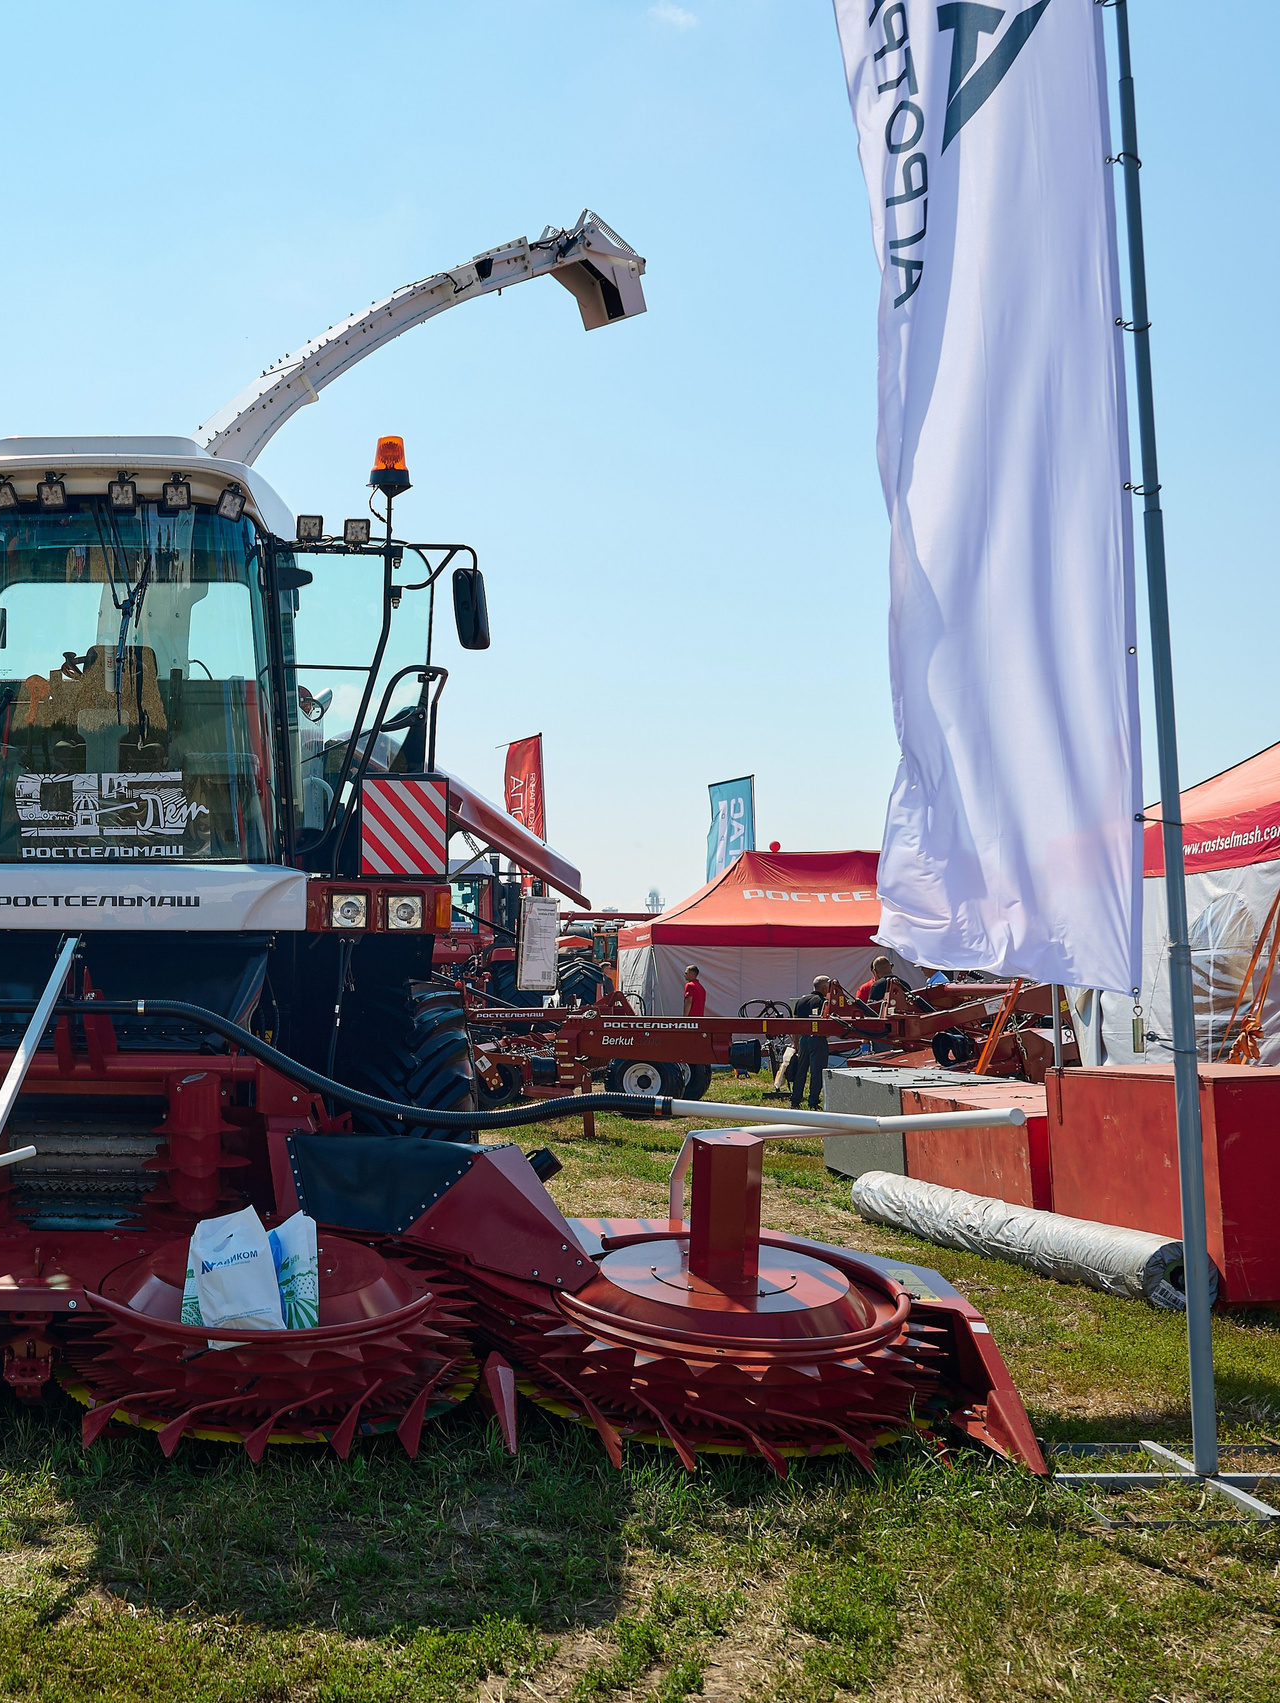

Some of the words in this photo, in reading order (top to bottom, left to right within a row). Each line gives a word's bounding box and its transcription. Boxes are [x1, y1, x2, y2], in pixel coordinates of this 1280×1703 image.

[1182, 825, 1280, 856] ww.rostselmash.co
[21, 845, 184, 858] РОСТСЕЛЬМАШ
[603, 1021, 699, 1030] РОСТСЕЛЬМАШ
[601, 1035, 634, 1046] Berkut
